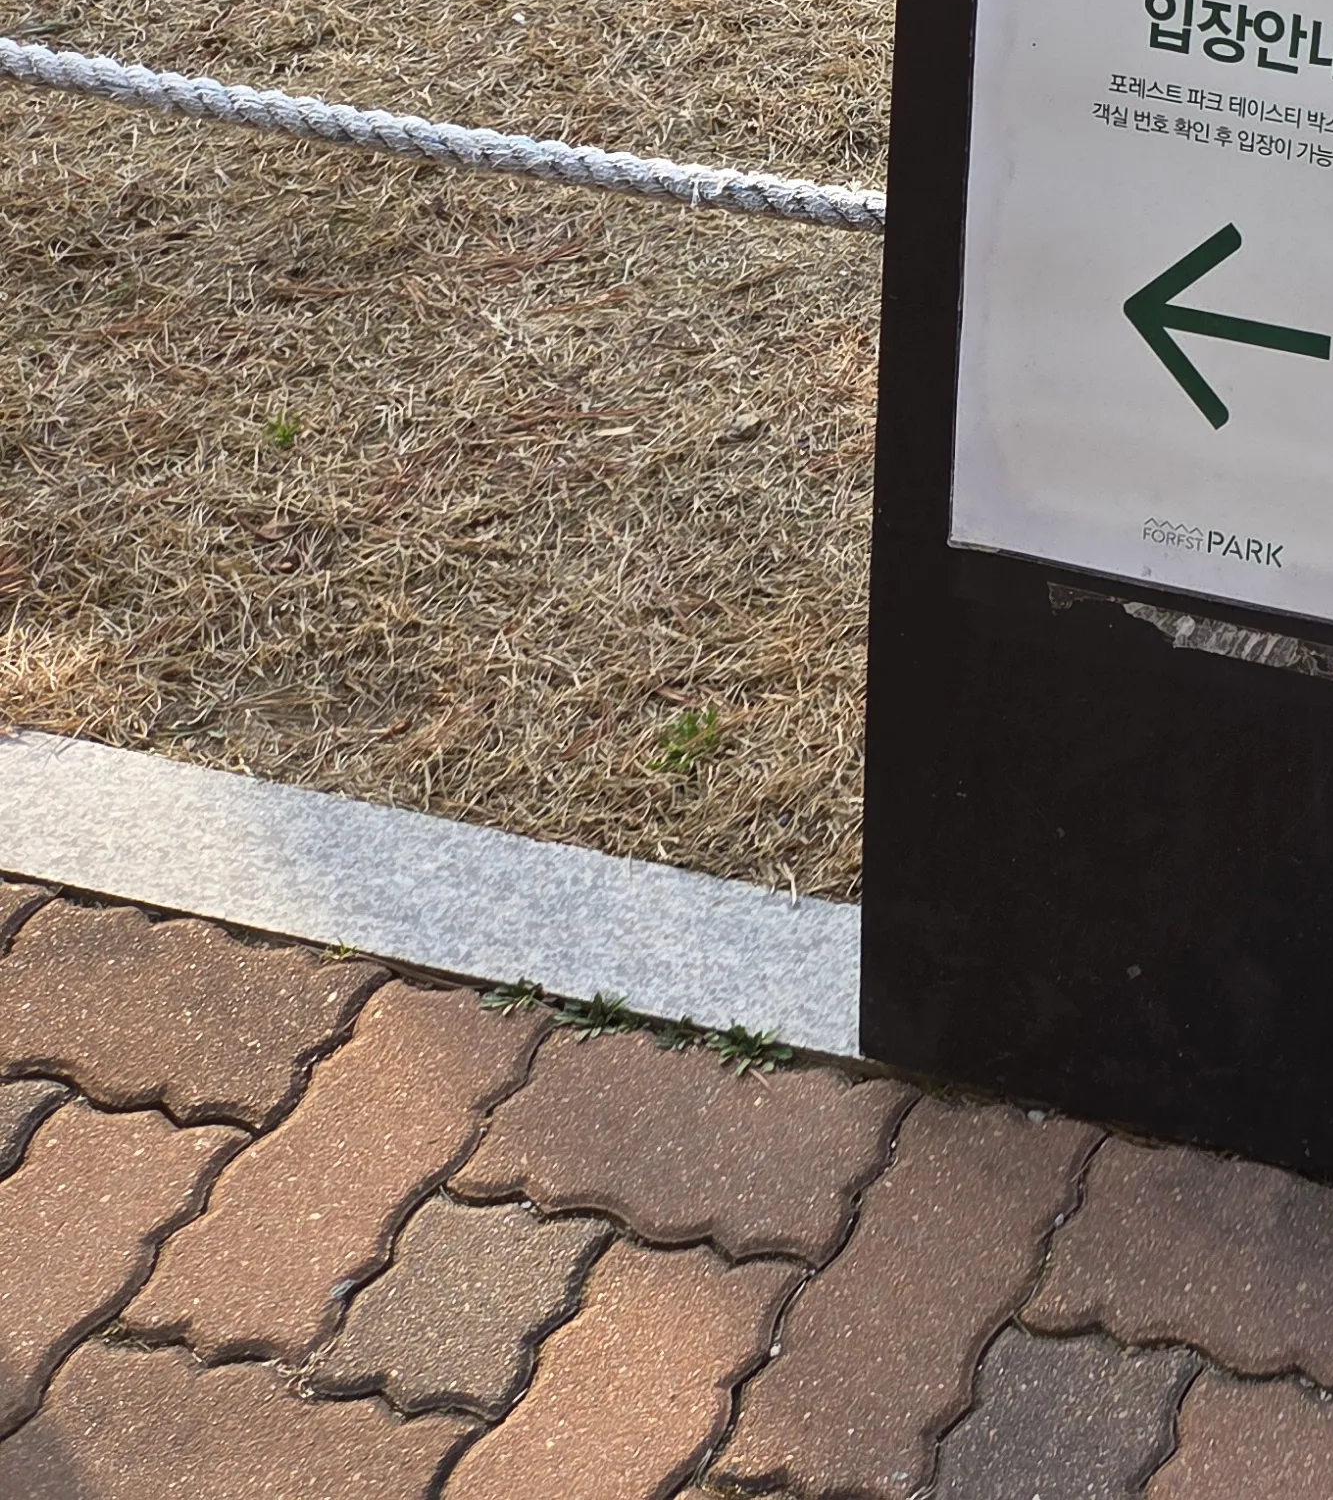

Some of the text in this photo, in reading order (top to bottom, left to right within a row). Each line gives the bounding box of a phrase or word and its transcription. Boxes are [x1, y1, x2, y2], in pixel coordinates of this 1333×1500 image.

[1107, 73, 1184, 104] 포레스트
[1186, 87, 1225, 112] 파크
[1228, 95, 1302, 128] 테이스티
[1091, 102, 1129, 129] 객실
[1133, 110, 1170, 135] 번호
[1173, 117, 1211, 144] 확인
[1213, 126, 1234, 148] 후
[1237, 129, 1292, 161] 입장이
[1143, 527, 1285, 569] FOREST PARK
